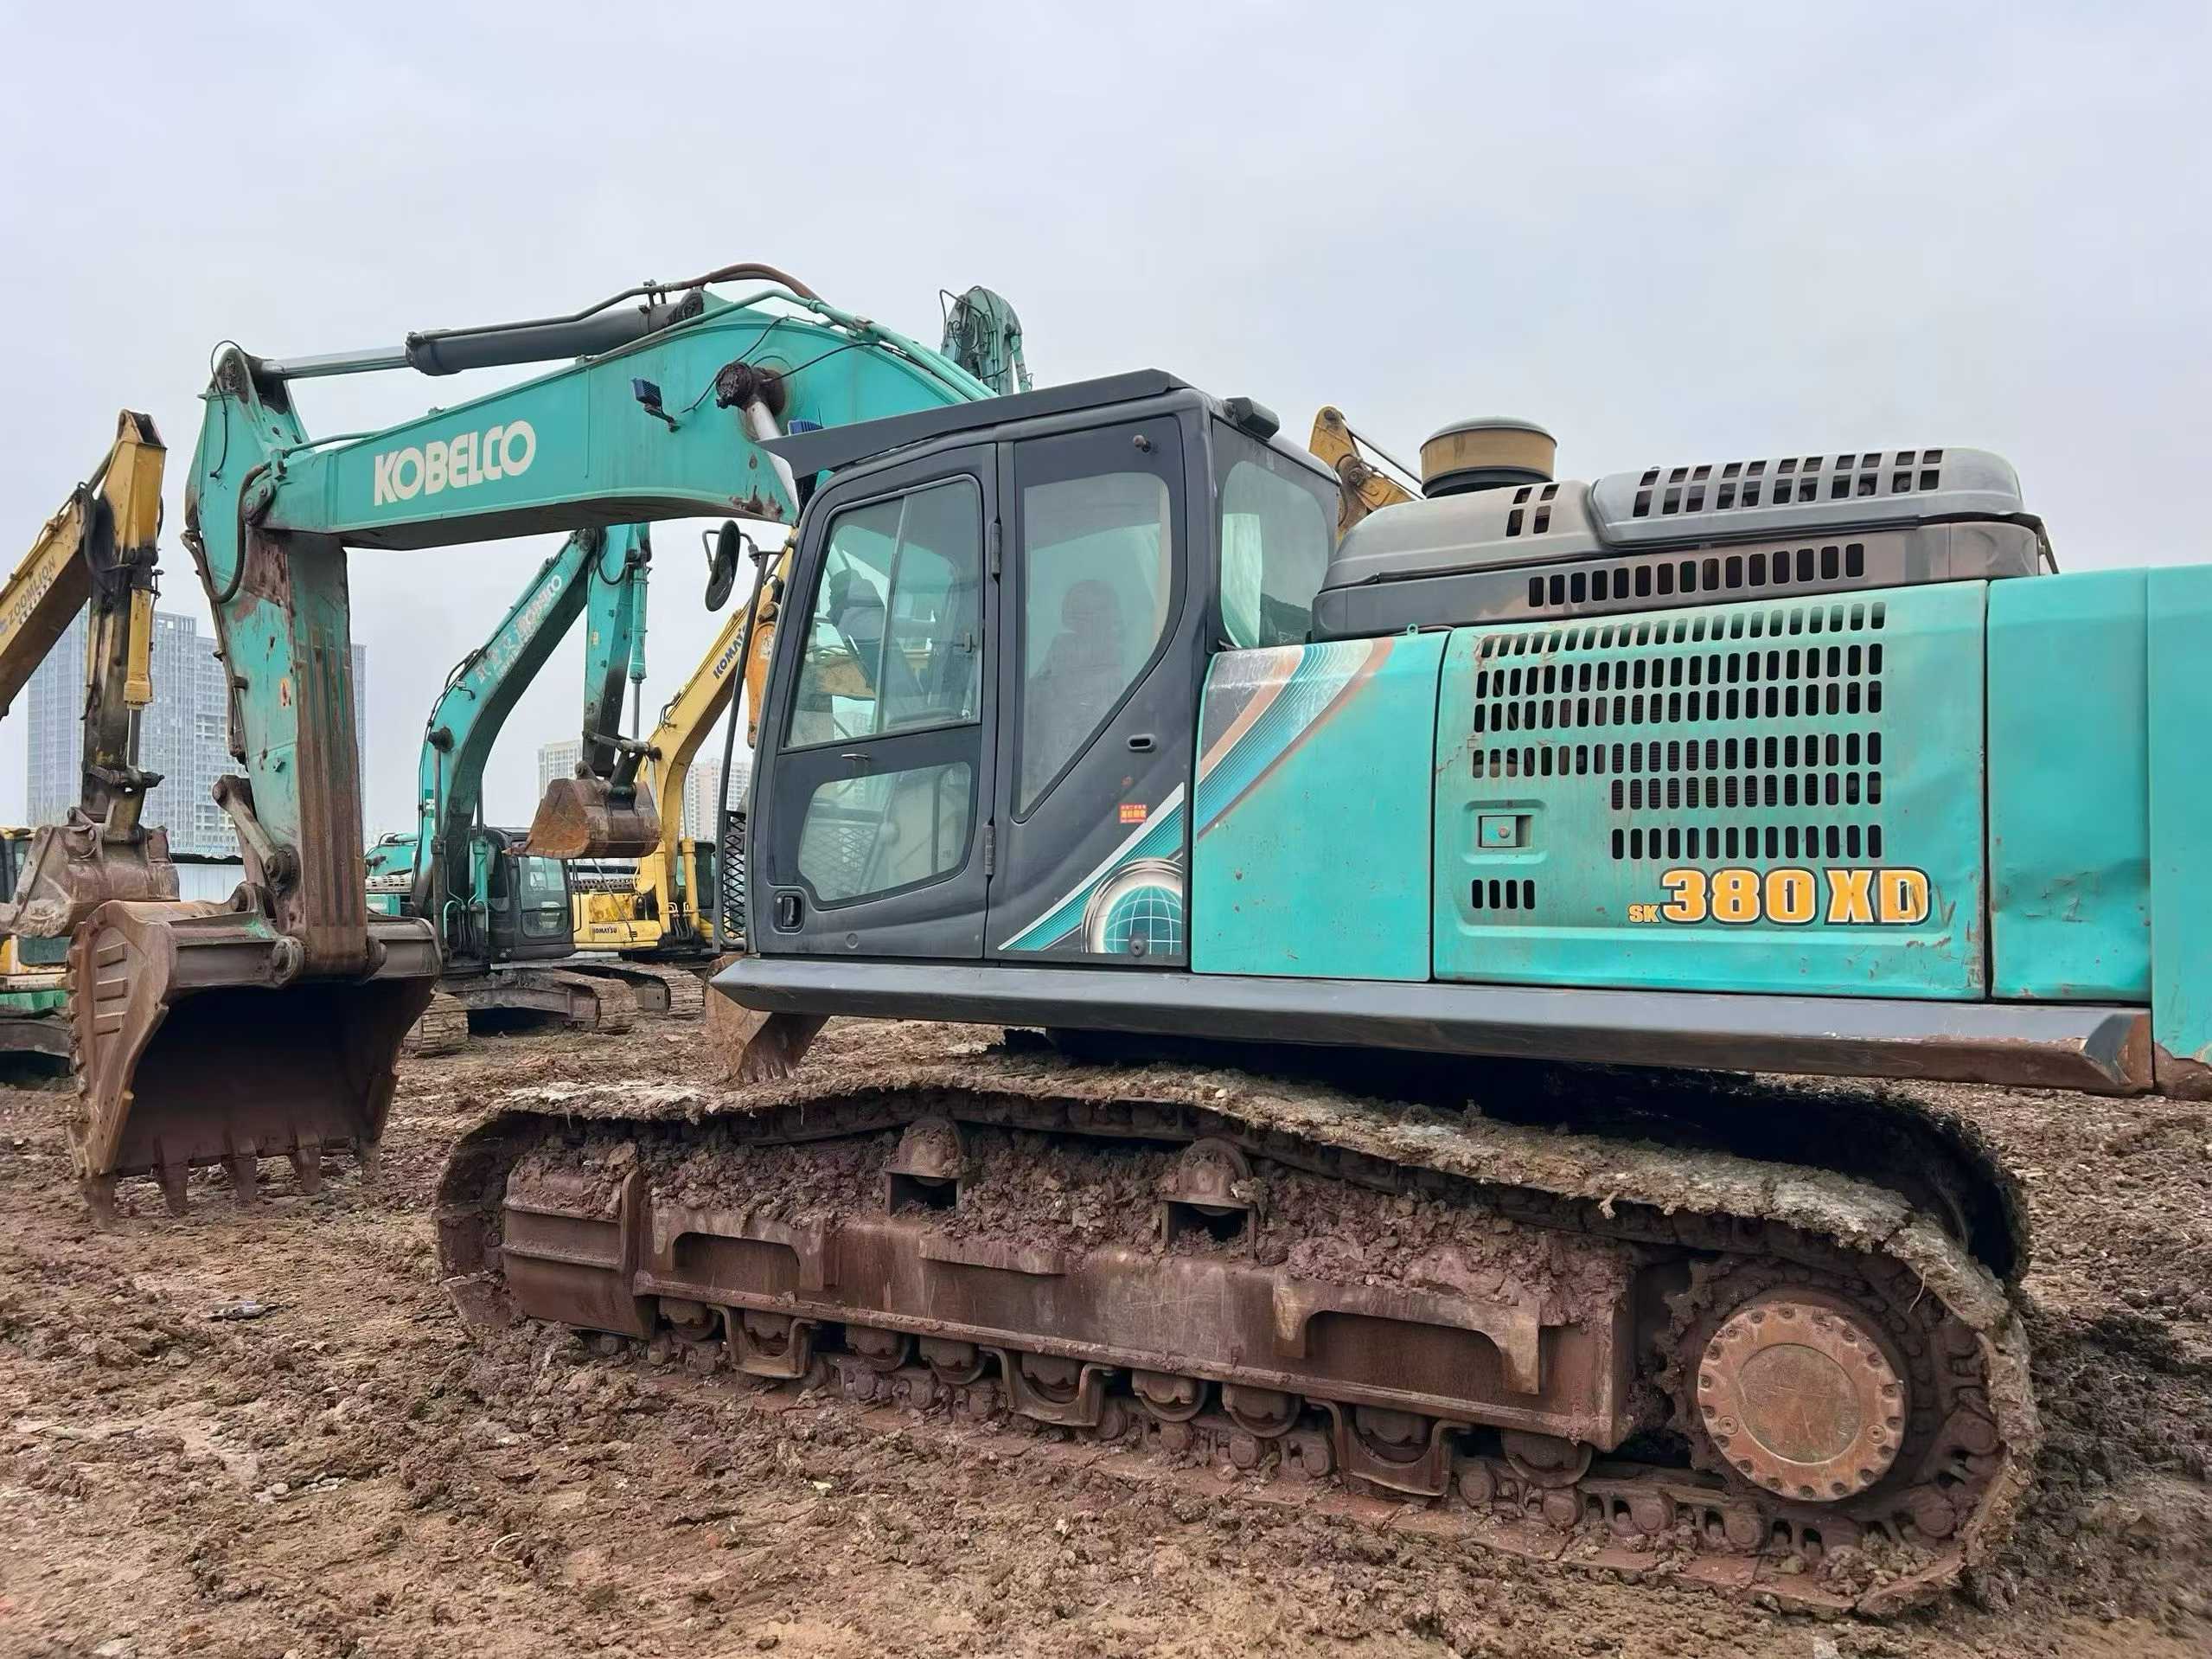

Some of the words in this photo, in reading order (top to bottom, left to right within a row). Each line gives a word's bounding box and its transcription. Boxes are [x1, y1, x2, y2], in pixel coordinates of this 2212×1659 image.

[374, 420, 537, 507] KOBELCO
[8, 555, 56, 625] ZOOMLION
[713, 625, 746, 680] KOMAT
